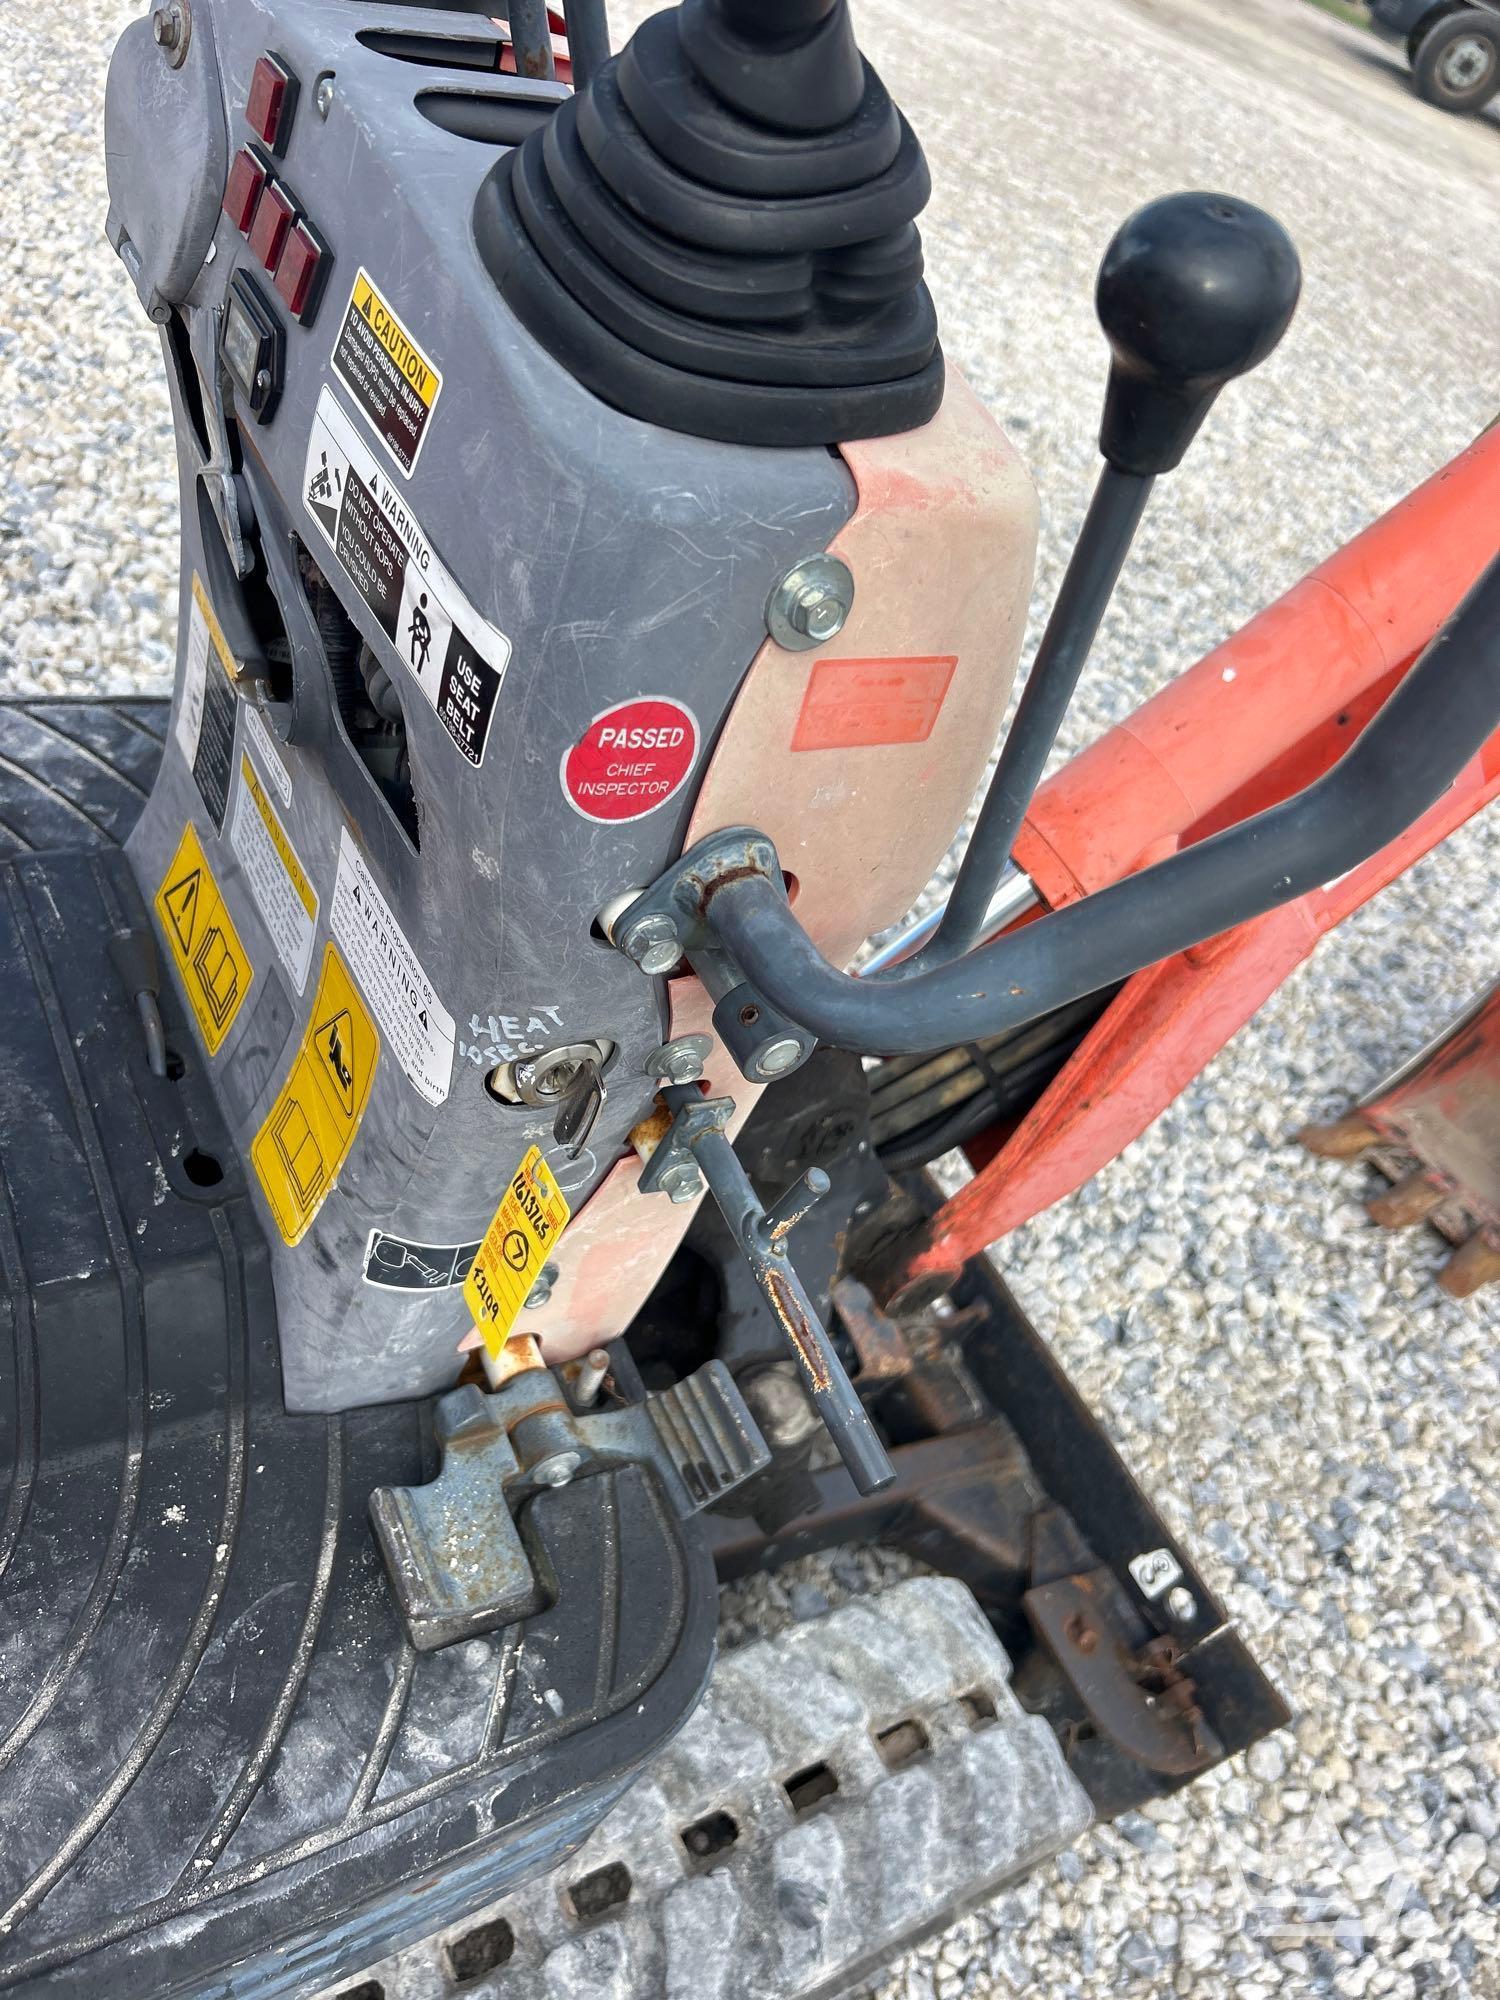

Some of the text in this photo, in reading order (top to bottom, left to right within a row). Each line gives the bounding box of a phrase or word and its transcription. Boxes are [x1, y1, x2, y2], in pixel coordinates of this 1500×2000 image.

[339, 343, 348, 360] not
[345, 352, 364, 387] repaired
[362, 380, 368, 392] or
[343, 325, 365, 365] Damaged
[363, 353, 379, 382] ROPS
[377, 375, 390, 399] must
[388, 390, 397, 409] be
[349, 308, 424, 423] TO AVOID PERSONAL INJURY:
[372, 304, 427, 394] CAUTION
[344, 496, 394, 580] WITHOUT ROPS.
[348, 476, 404, 568] DO NOT OPERATE
[382, 485, 430, 572] WARNING
[338, 540, 370, 597] CRUSHED.
[340, 522, 387, 600] YOU COULD BE
[448, 673, 479, 725] SEAT
[456, 654, 481, 698] USE
[445, 696, 474, 745] BELT
[598, 728, 684, 748] PASSED
[578, 781, 668, 795] INSPECTOR
[606, 763, 656, 776] CHIEF
[262, 800, 304, 893] CAUTION
[355, 857, 432, 1007] California Proposition 65
[363, 899, 418, 1009] WARNING
[351, 938, 372, 985] California
[410, 1056, 423, 1079] and
[424, 1076, 445, 1096] birth
[369, 946, 399, 1007] components
[398, 1001, 408, 1024] and
[391, 1003, 407, 1039] known
[408, 1035, 414, 1051] to
[414, 1046, 424, 1068] the
[468, 1006, 563, 1042] HEAT
[501, 1205, 513, 1228] MAKE
[508, 1192, 520, 1215] YEAR
[546, 1208, 558, 1231] USED
